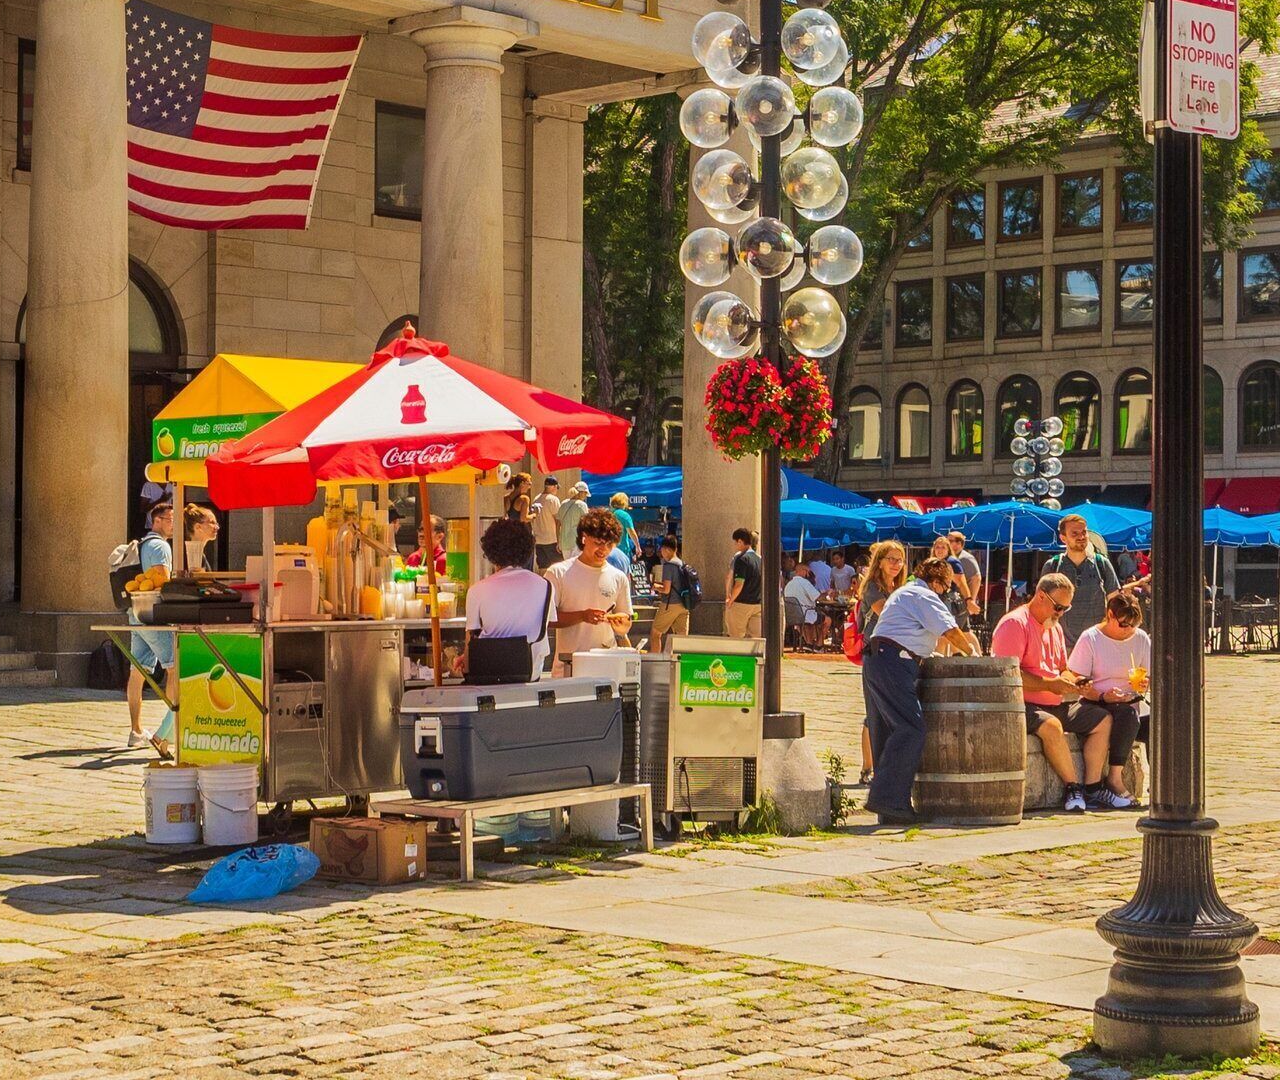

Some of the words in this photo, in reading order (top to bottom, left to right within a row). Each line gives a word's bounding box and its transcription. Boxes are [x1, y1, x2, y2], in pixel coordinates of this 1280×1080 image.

[1191, 20, 1216, 44] NO
[1172, 43, 1234, 70] STOPPING
[1190, 74, 1215, 93] Fire
[1187, 94, 1219, 114] Lane
[192, 423, 210, 434] fresh
[212, 421, 248, 435] squeezed
[556, 433, 593, 457] Coca-Cola
[381, 442, 459, 469] Coca-Cola
[629, 495, 648, 504] CHIPS
[682, 683, 754, 703] lemonade
[194, 714, 212, 725] fresh
[213, 717, 247, 729] squeezed
[182, 726, 260, 754] lemonade
